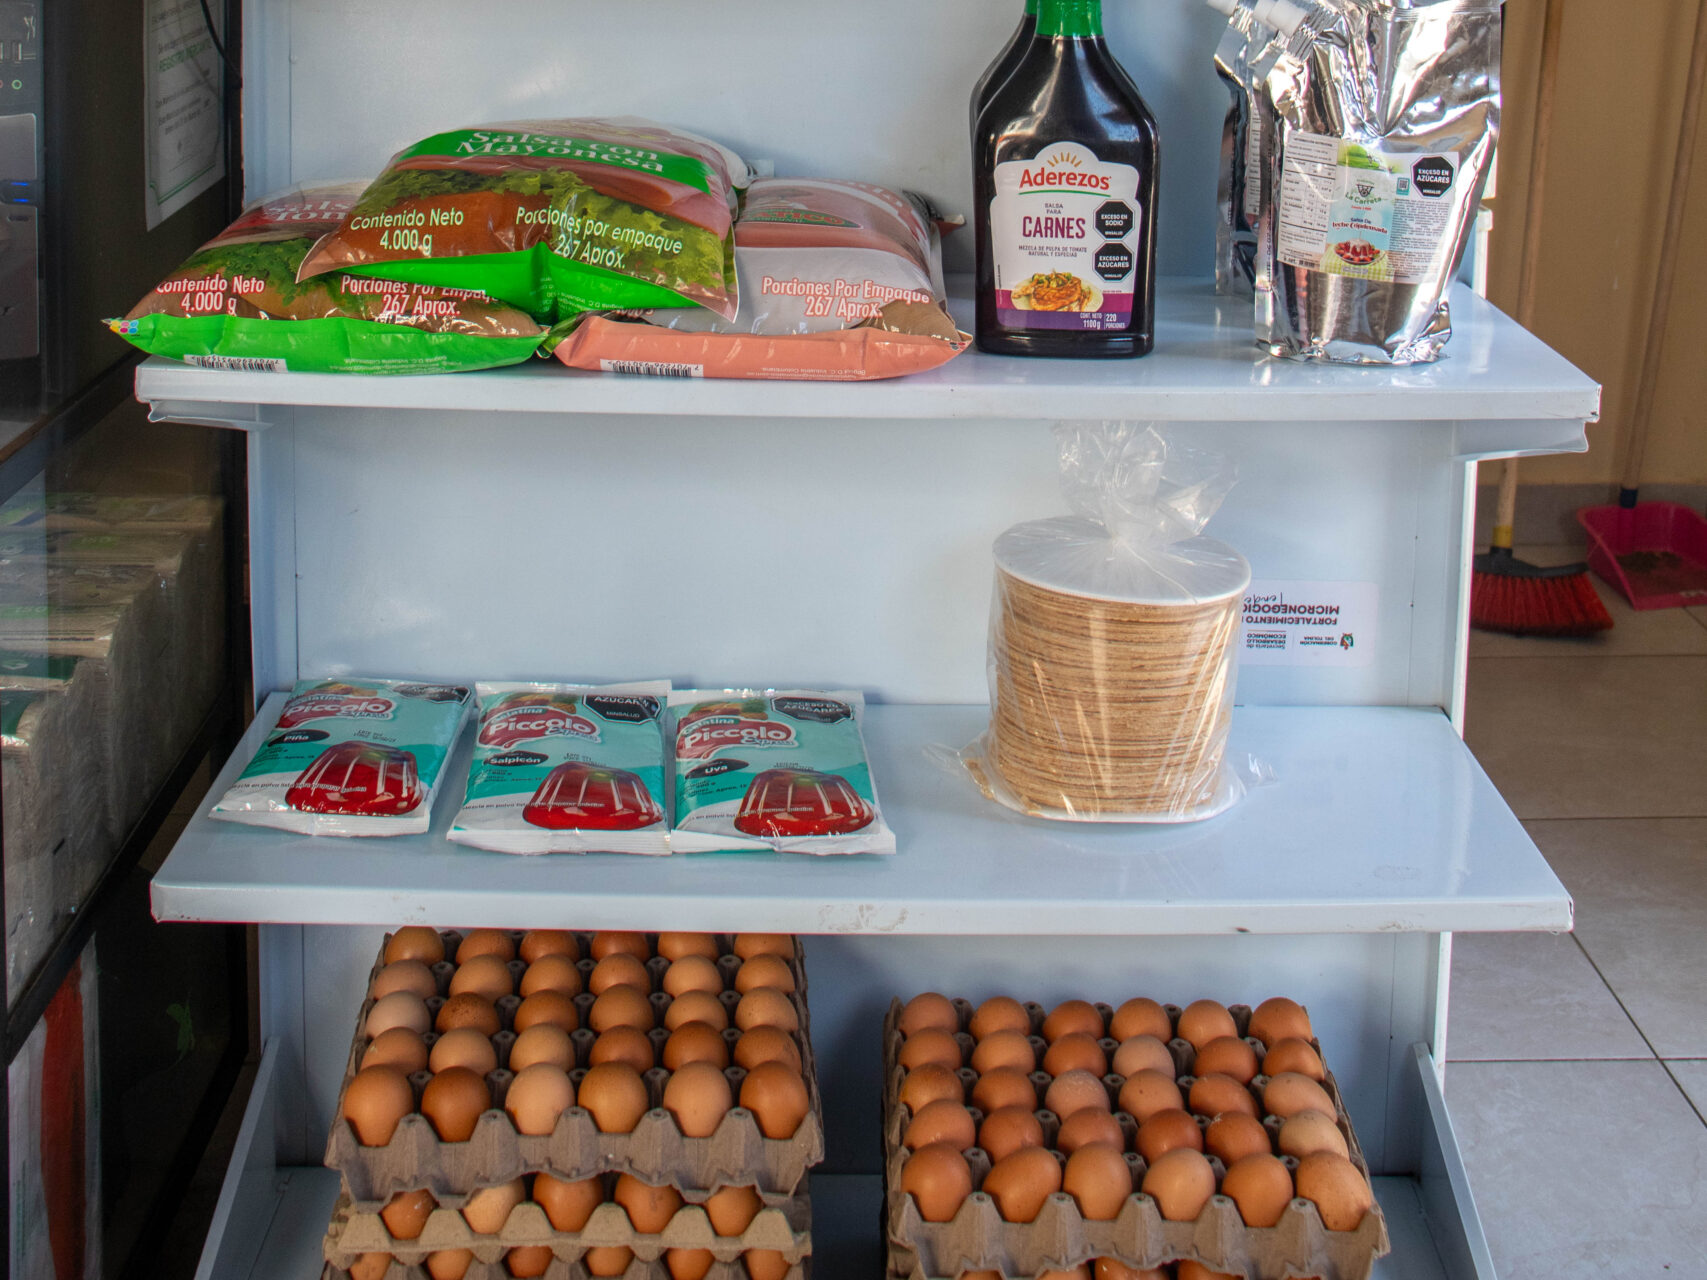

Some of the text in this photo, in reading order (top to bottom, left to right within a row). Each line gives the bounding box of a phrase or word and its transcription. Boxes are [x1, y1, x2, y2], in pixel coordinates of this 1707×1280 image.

[456, 142, 664, 173] Mayonesa
[468, 132, 658, 160] Salsa con
[1019, 166, 1110, 190] Aderezos
[1416, 174, 1450, 184] AZÚCARES
[1418, 168, 1441, 176] EXCESO
[350, 207, 464, 230] Contenido Neto
[1022, 216, 1086, 240] CARNES
[380, 228, 432, 256] 4.000 g
[516, 206, 683, 255] Porciones por empaque
[554, 233, 626, 270] 267 Aprox.
[1097, 260, 1130, 268] AZÚCARES
[233, 274, 265, 294] Neto
[340, 274, 408, 295] Porciones
[762, 276, 930, 304] Porciones Por Empaque
[181, 292, 238, 316] 4.000 g
[382, 294, 461, 315] 267 Aprox.
[806, 296, 884, 319] 267 Aprox.
[1106, 313, 1116, 322] 220
[1245, 616, 1338, 626] FORTALECIMIENTO
[488, 718, 592, 736] Piccolo
[684, 726, 788, 750] Piccolo
[490, 756, 541, 765] Salpicón
[704, 764, 728, 774] Uva
